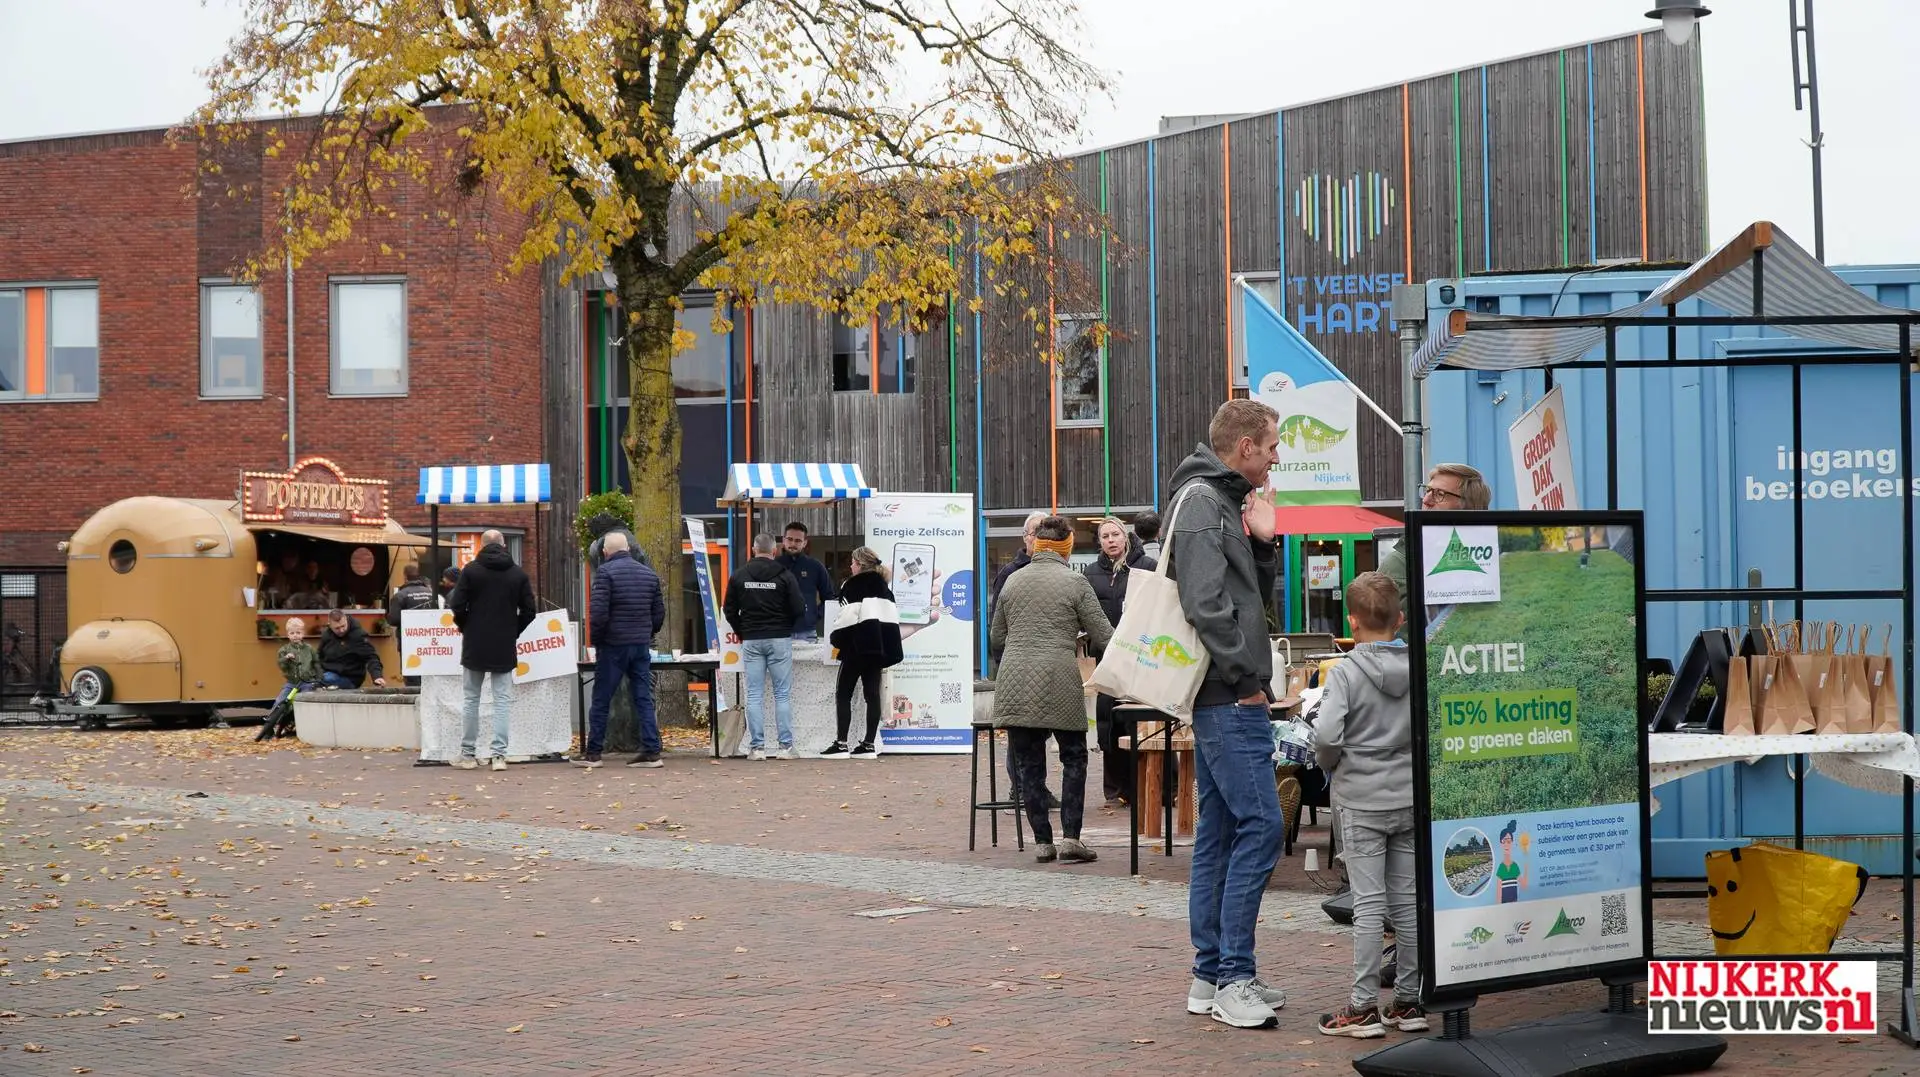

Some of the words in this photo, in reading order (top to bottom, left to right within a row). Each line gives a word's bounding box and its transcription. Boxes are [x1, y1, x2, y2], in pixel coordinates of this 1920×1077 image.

[1314, 273, 1404, 295] VEENSE
[1298, 300, 1397, 334] HART
[1523, 424, 1555, 469] GROEN
[1270, 460, 1330, 472] uurzaam
[1777, 445, 1896, 476] ingang
[1314, 473, 1352, 485] Nijkerk
[1532, 457, 1554, 496] DAK
[266, 480, 365, 510] POFFERTJES
[1541, 482, 1565, 511] TUIN
[872, 527, 915, 538] Energie
[918, 527, 965, 537] Zelfscan
[1450, 543, 1493, 561] Harco
[405, 627, 462, 637] WARMTEPOM
[725, 632, 743, 644] SO
[416, 646, 454, 656] BATTERIJ
[431, 638, 438, 646] &
[516, 635, 566, 655] SOLEREN
[1440, 643, 1525, 675] ACTIE!
[1444, 700, 1488, 726] 15%
[1495, 694, 1572, 725] korting
[1444, 735, 1465, 755] op
[1469, 732, 1524, 753] groene
[1527, 726, 1573, 745] daken
[1537, 823, 1552, 831] Deze
[1553, 821, 1574, 830] korting
[1537, 835, 1561, 844] subsidie
[1588, 832, 1605, 841] groen
[1606, 829, 1617, 837] dak
[1538, 850, 1546, 858] de
[1577, 846, 1588, 854] van
[1604, 843, 1614, 851] per
[1558, 915, 1586, 928] Harco
